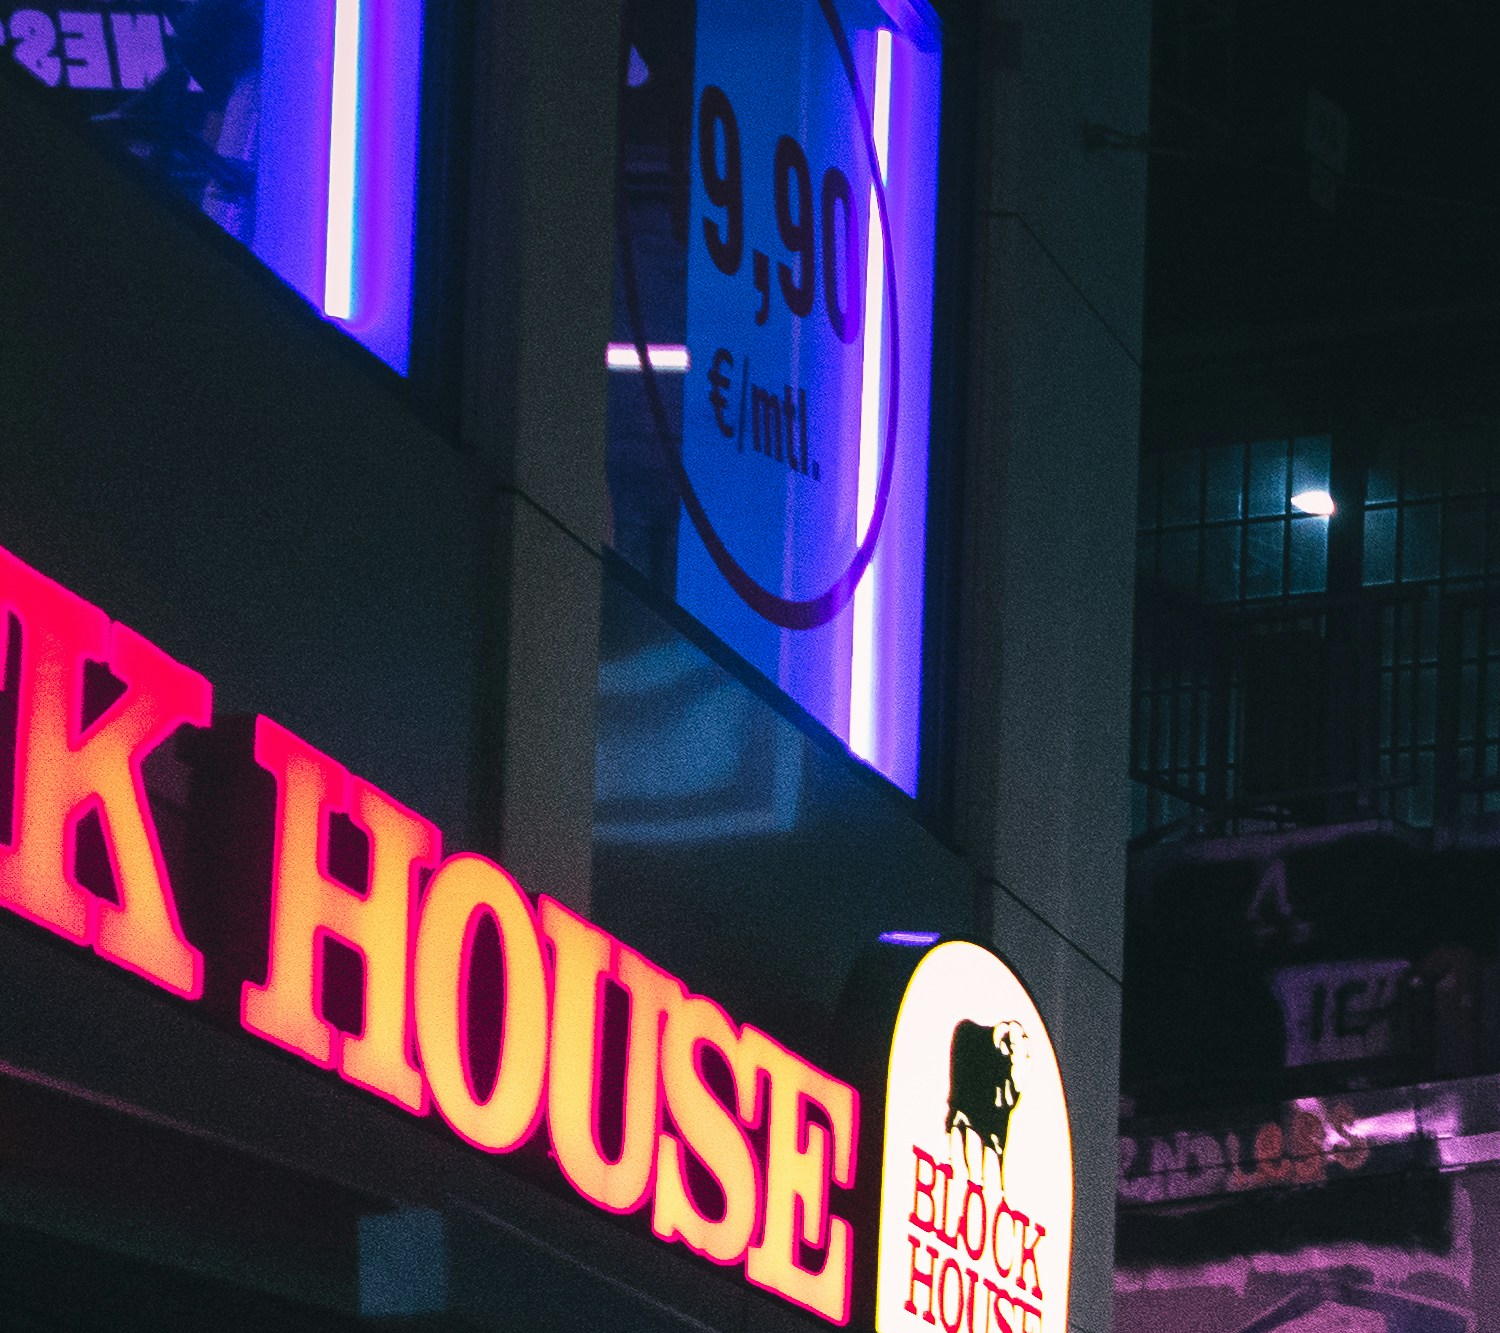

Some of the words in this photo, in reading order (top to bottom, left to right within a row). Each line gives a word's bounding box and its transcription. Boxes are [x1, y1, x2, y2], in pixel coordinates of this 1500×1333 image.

[699, 85, 861, 345] 9,90
[707, 347, 821, 482] €/mtl.
[239, 712, 861, 1327] HOUSE
[907, 1143, 1047, 1301] BLOCK
